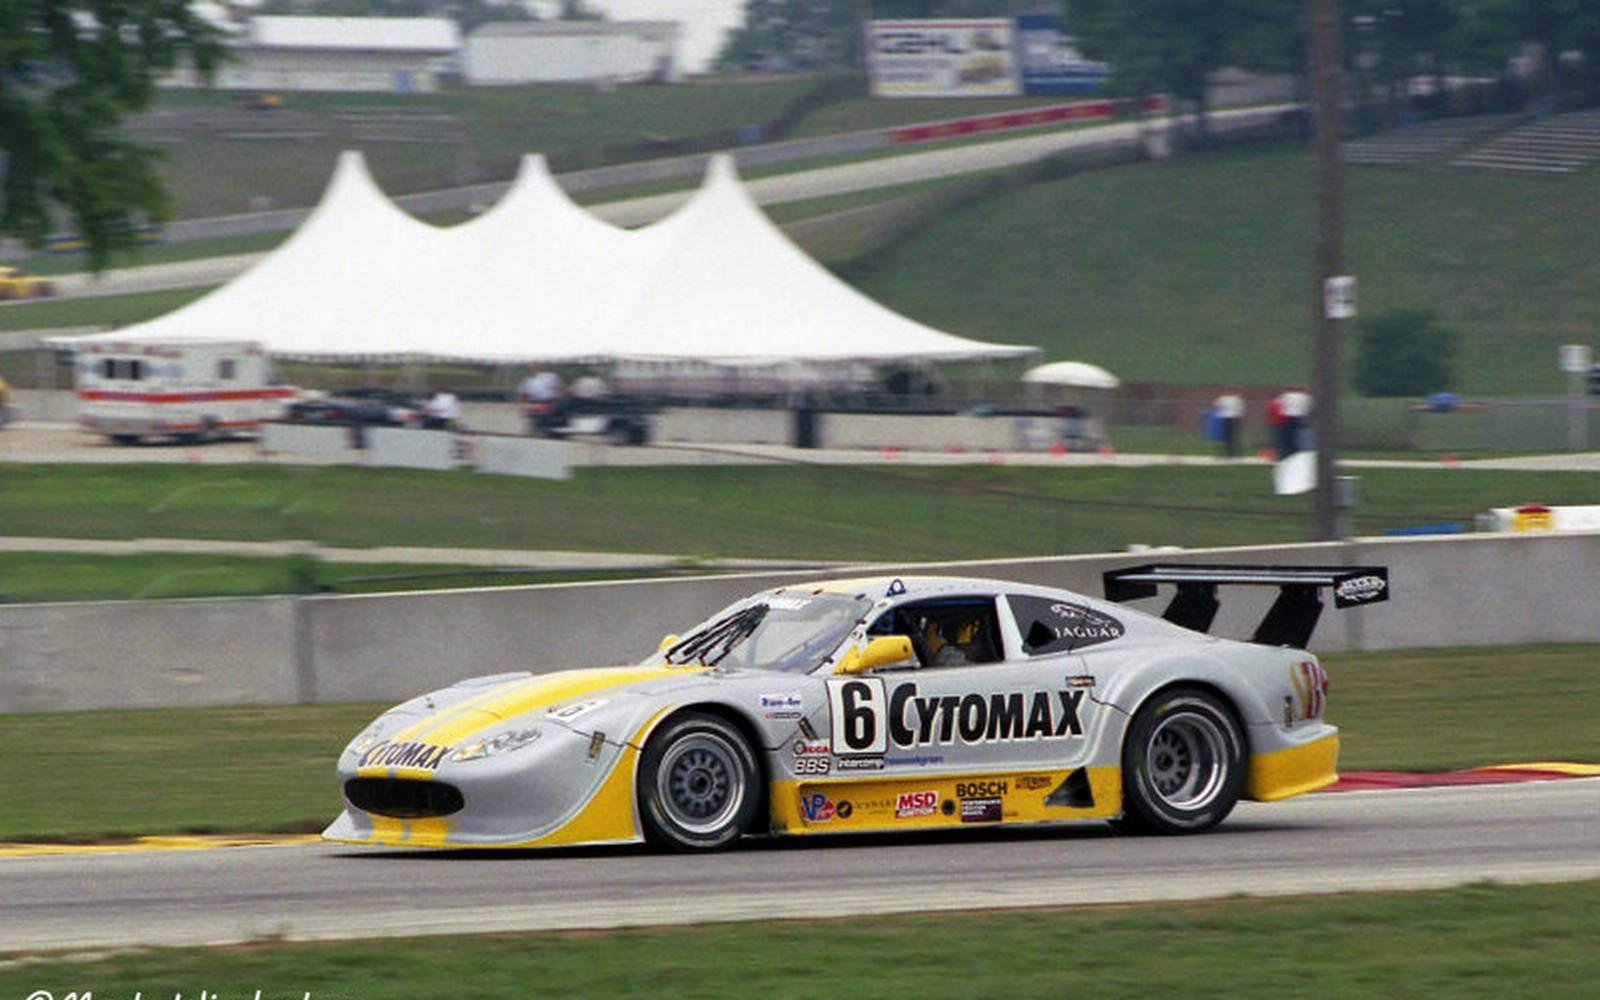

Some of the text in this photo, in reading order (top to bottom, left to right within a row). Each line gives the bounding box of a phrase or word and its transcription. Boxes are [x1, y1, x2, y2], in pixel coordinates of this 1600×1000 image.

[1054, 625, 1121, 639] JAGUAR
[841, 681, 875, 750] 6
[794, 757, 830, 775] BBS
[956, 782, 1008, 798] BOSCH
[899, 792, 937, 810] MSD
